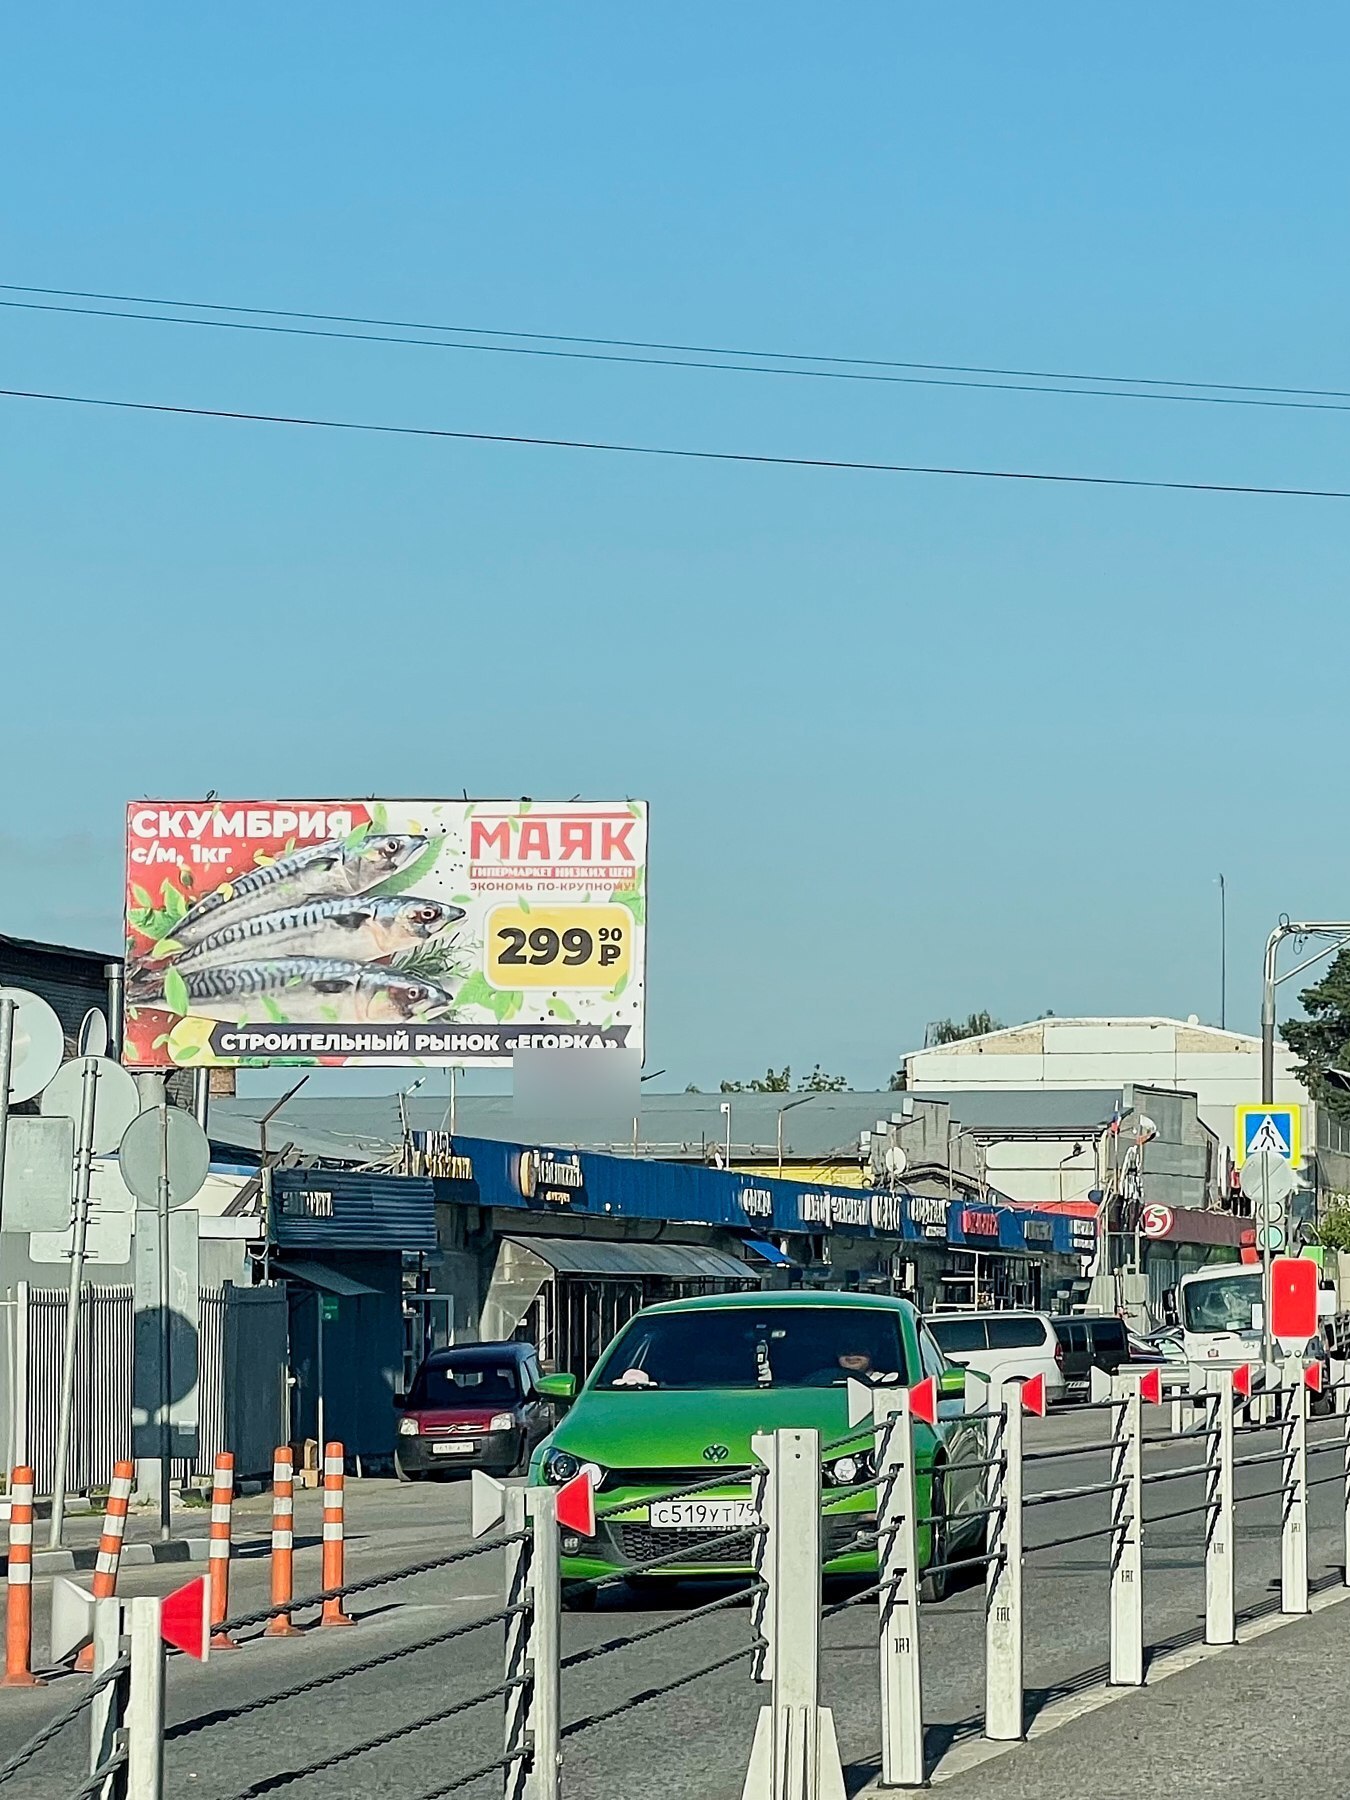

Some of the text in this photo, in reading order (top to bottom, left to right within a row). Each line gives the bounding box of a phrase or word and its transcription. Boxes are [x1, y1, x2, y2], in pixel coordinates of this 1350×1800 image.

[131, 810, 352, 838] СКУМБРИЯ
[470, 822, 635, 860] МАЯК
[131, 840, 232, 866] с/м, 1кг
[471, 867, 633, 879] ГИПЕРМАРКЕТ НИЗКИХ ЦЕН
[470, 882, 635, 891] ЭКОНОМЬ ПО-КРУПНОМУ!
[598, 927, 623, 941] 90
[497, 927, 593, 965] 299
[220, 1030, 618, 1051] СТРОИТЕЛЬНЫЙ РЫНОК «ЕГОРКА»
